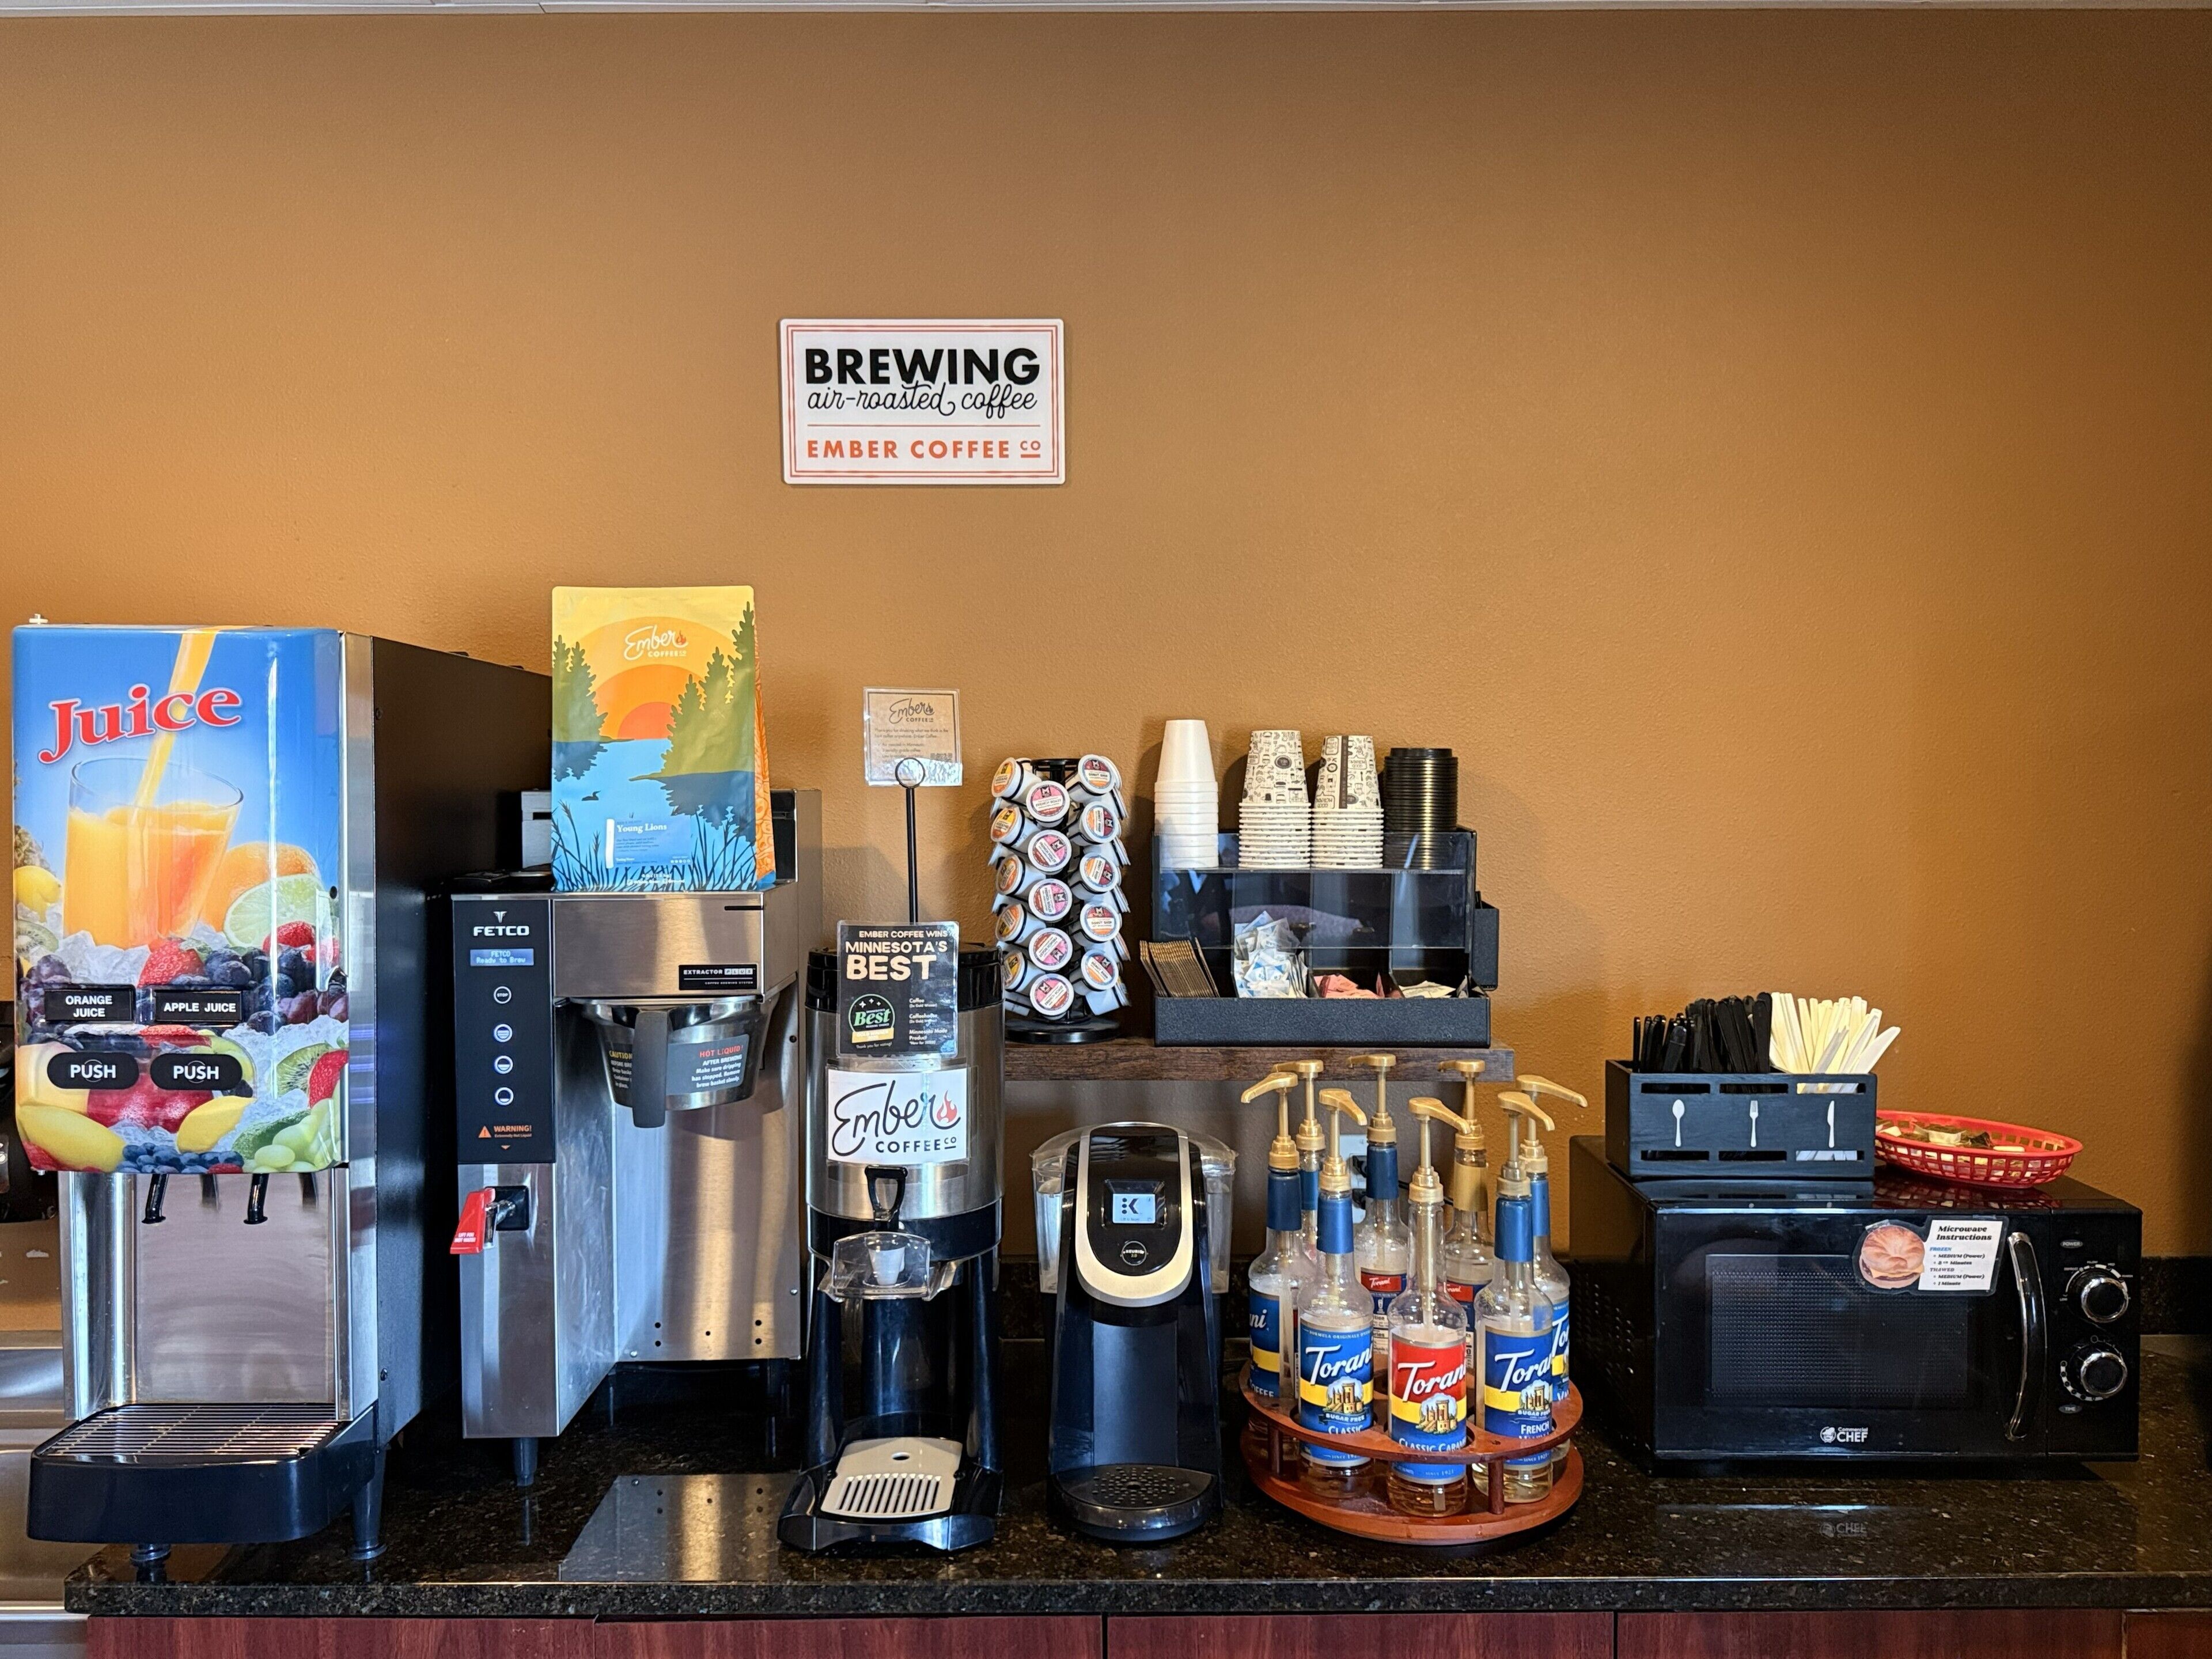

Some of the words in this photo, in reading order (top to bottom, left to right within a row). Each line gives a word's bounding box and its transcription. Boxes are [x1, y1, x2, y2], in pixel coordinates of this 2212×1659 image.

[806, 348, 1040, 385] BREWING
[808, 381, 956, 416] air-roasted
[961, 384, 1038, 419] coffee
[808, 440, 899, 459] EMBER
[910, 440, 1010, 459] COFFEE
[1020, 440, 1040, 453] CO
[624, 624, 688, 660] Ember
[889, 698, 935, 724] Ember
[39, 684, 241, 763] Juice
[617, 824, 643, 834] Young
[645, 823, 667, 831] Lions
[474, 926, 529, 936] FETCO
[846, 941, 948, 953] MINNESOTA'S
[847, 955, 937, 980] BEST
[66, 995, 112, 1005] ORANGE
[73, 1008, 105, 1017] JUICE
[164, 1003, 199, 1012] APPLE
[204, 1003, 236, 1012] JUICE
[853, 1009, 891, 1026] Best
[609, 1051, 632, 1059] CAUTION
[721, 1054, 742, 1063] BREWING
[70, 1065, 116, 1078] PUSH
[173, 1066, 219, 1080] PUSH
[832, 1080, 960, 1156] Ember
[876, 1139, 941, 1153] COFFEE
[944, 1137, 957, 1145] CO
[1325, 1413, 1349, 1422] SUGAR
[1328, 1425, 1363, 1434] CLASSIC
[1521, 1421, 1550, 1434] FRENCH
[1836, 1431, 1868, 1442] CHEF
[1399, 1438, 1436, 1452] CLASSIC
